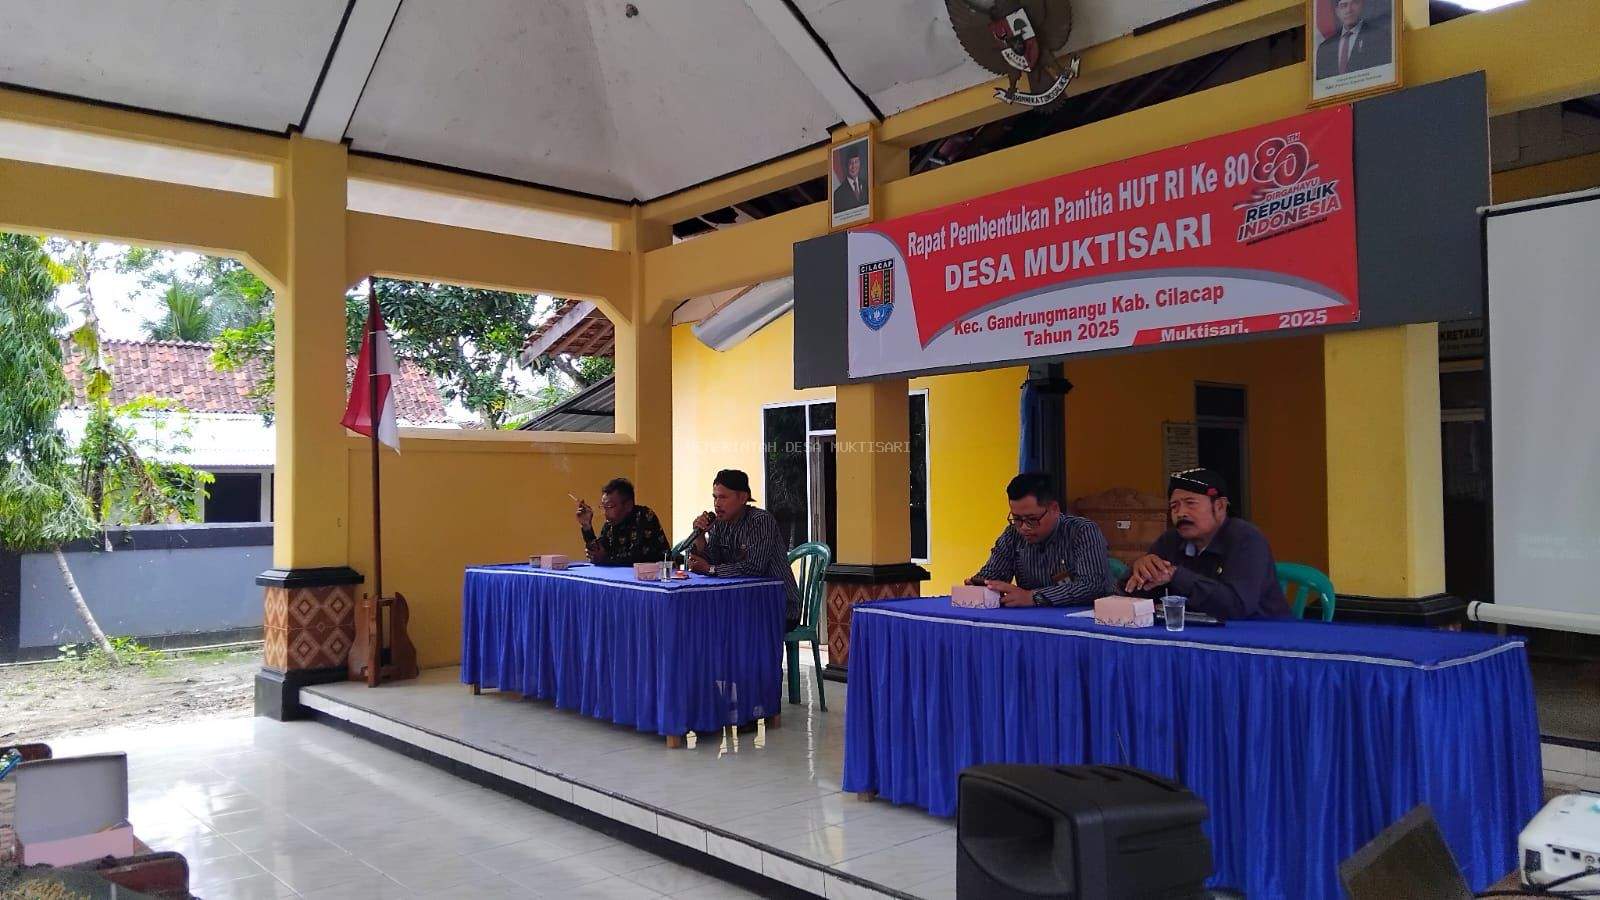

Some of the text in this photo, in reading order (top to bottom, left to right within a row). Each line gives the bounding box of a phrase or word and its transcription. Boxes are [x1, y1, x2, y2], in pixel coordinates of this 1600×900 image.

[908, 153, 1249, 260] Rapat Pembentukan Panitia HUT RI Ke 80
[1237, 194, 1342, 242] INDONESIA
[1246, 180, 1339, 223] REPUBLIK
[860, 260, 893, 273] CILACAP
[945, 254, 1016, 292] DESA
[1024, 213, 1212, 278] MUKTISARI
[953, 285, 1225, 336] Kec. Gandrungmangu Kab. Cilacap
[1024, 319, 1120, 347] Tahun 2025
[1279, 310, 1328, 329] 2025
